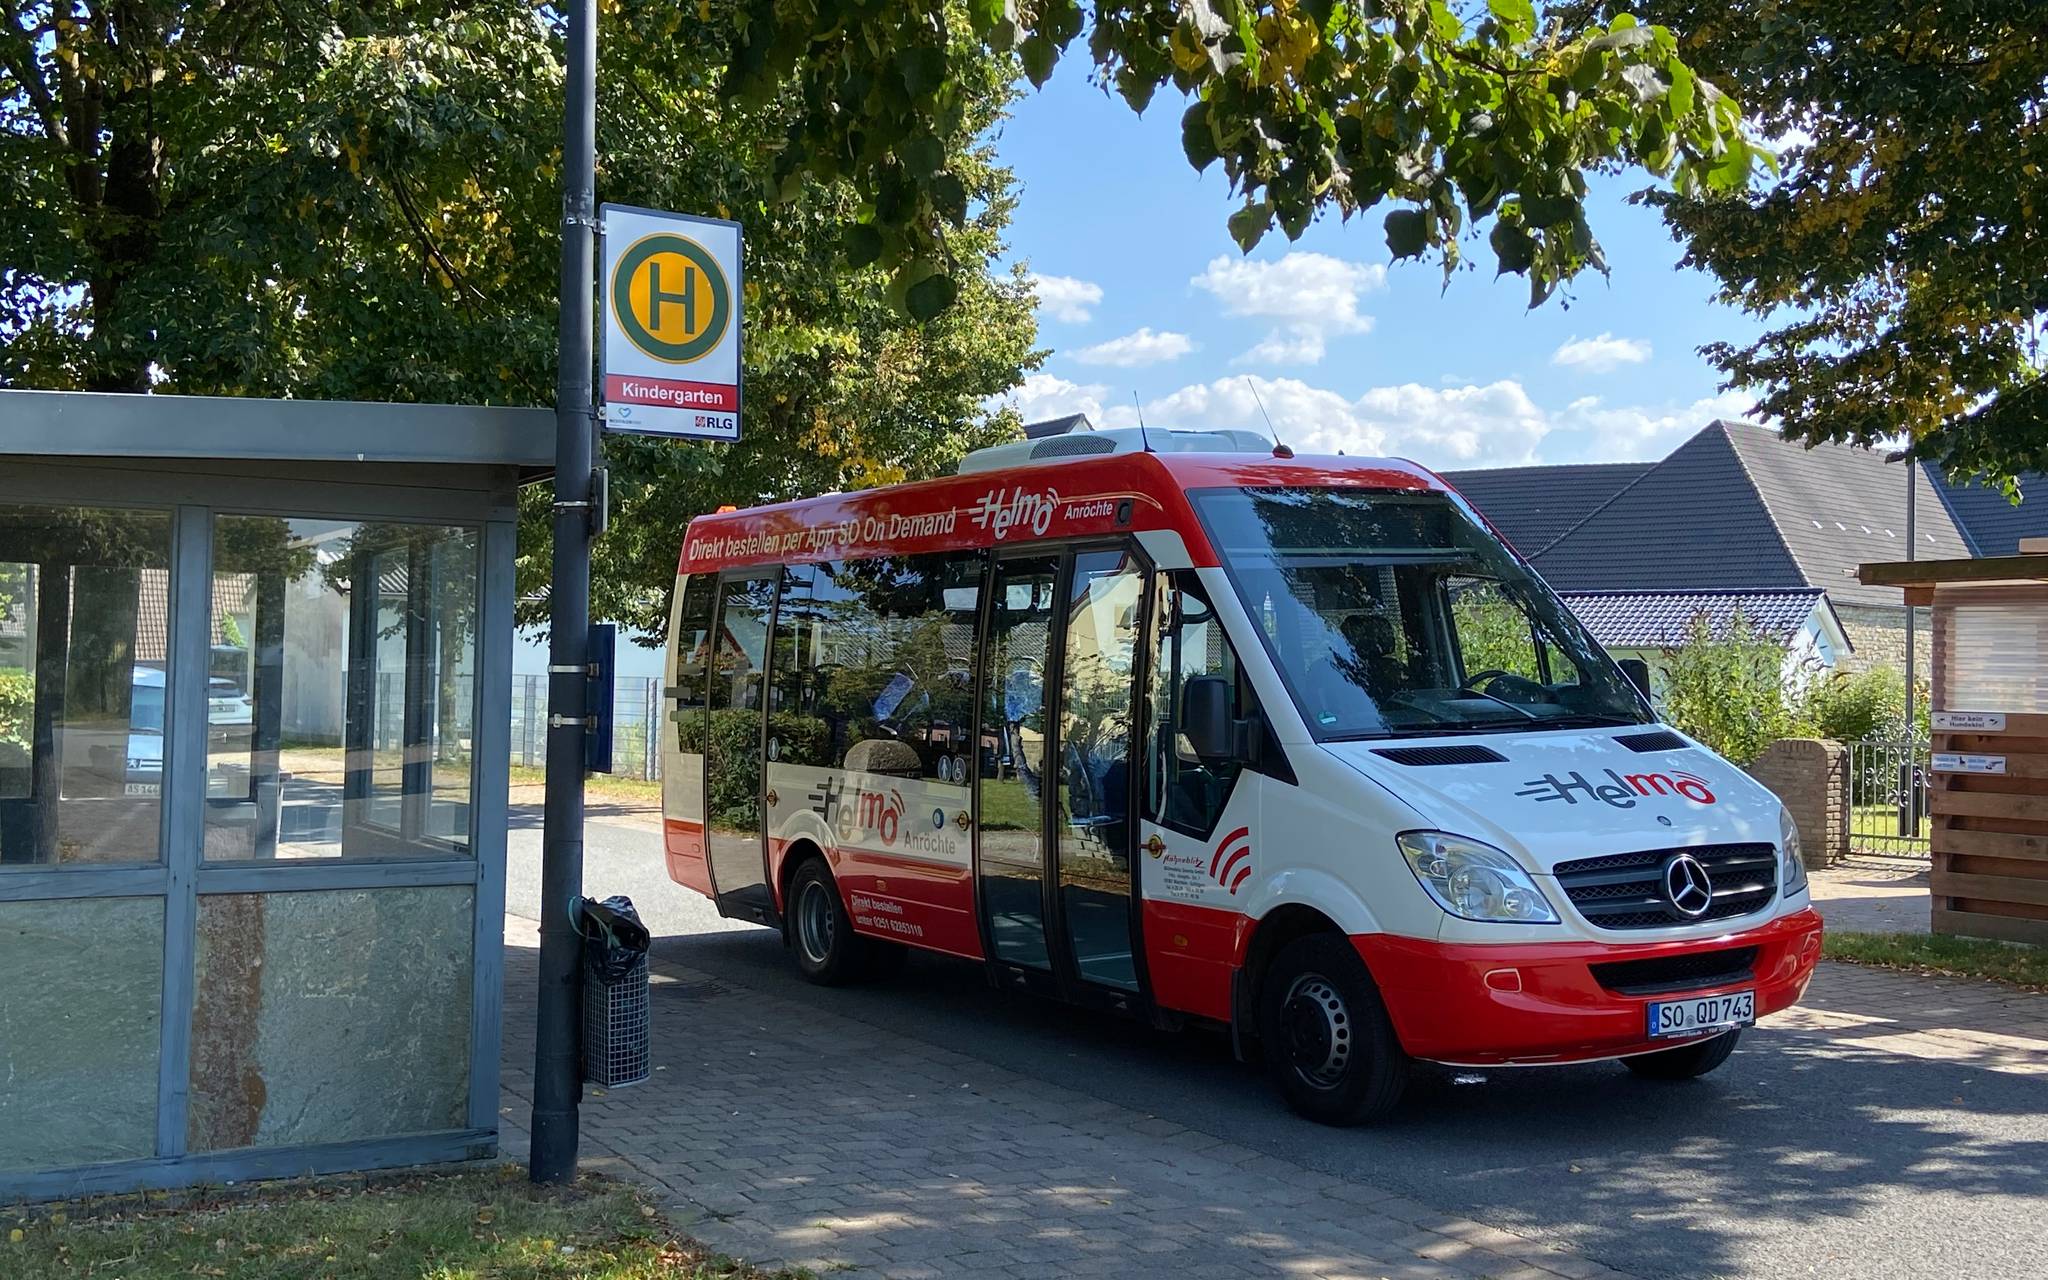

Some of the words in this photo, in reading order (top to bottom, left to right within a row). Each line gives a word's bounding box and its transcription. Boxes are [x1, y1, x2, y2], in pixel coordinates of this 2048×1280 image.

[650, 262, 695, 335] H
[622, 382, 723, 405] Kindergarten
[707, 417, 733, 430] RLG
[971, 486, 1055, 540] Helmo
[1064, 501, 1113, 520] Anröchte
[689, 537, 725, 561] Direkt
[725, 531, 780, 557] bestellen
[781, 531, 806, 556] per
[805, 524, 835, 554] App
[838, 518, 860, 545] SO
[863, 516, 885, 542] On
[888, 506, 957, 541] Demand
[1516, 768, 1717, 809] Helmo
[903, 830, 956, 855] Anröchte
[851, 894, 872, 909] Direkt
[872, 898, 903, 914] bestellen
[1661, 1005, 1684, 1028] SO
[1696, 1000, 1718, 1024] QD
[1722, 995, 1752, 1020] 743
